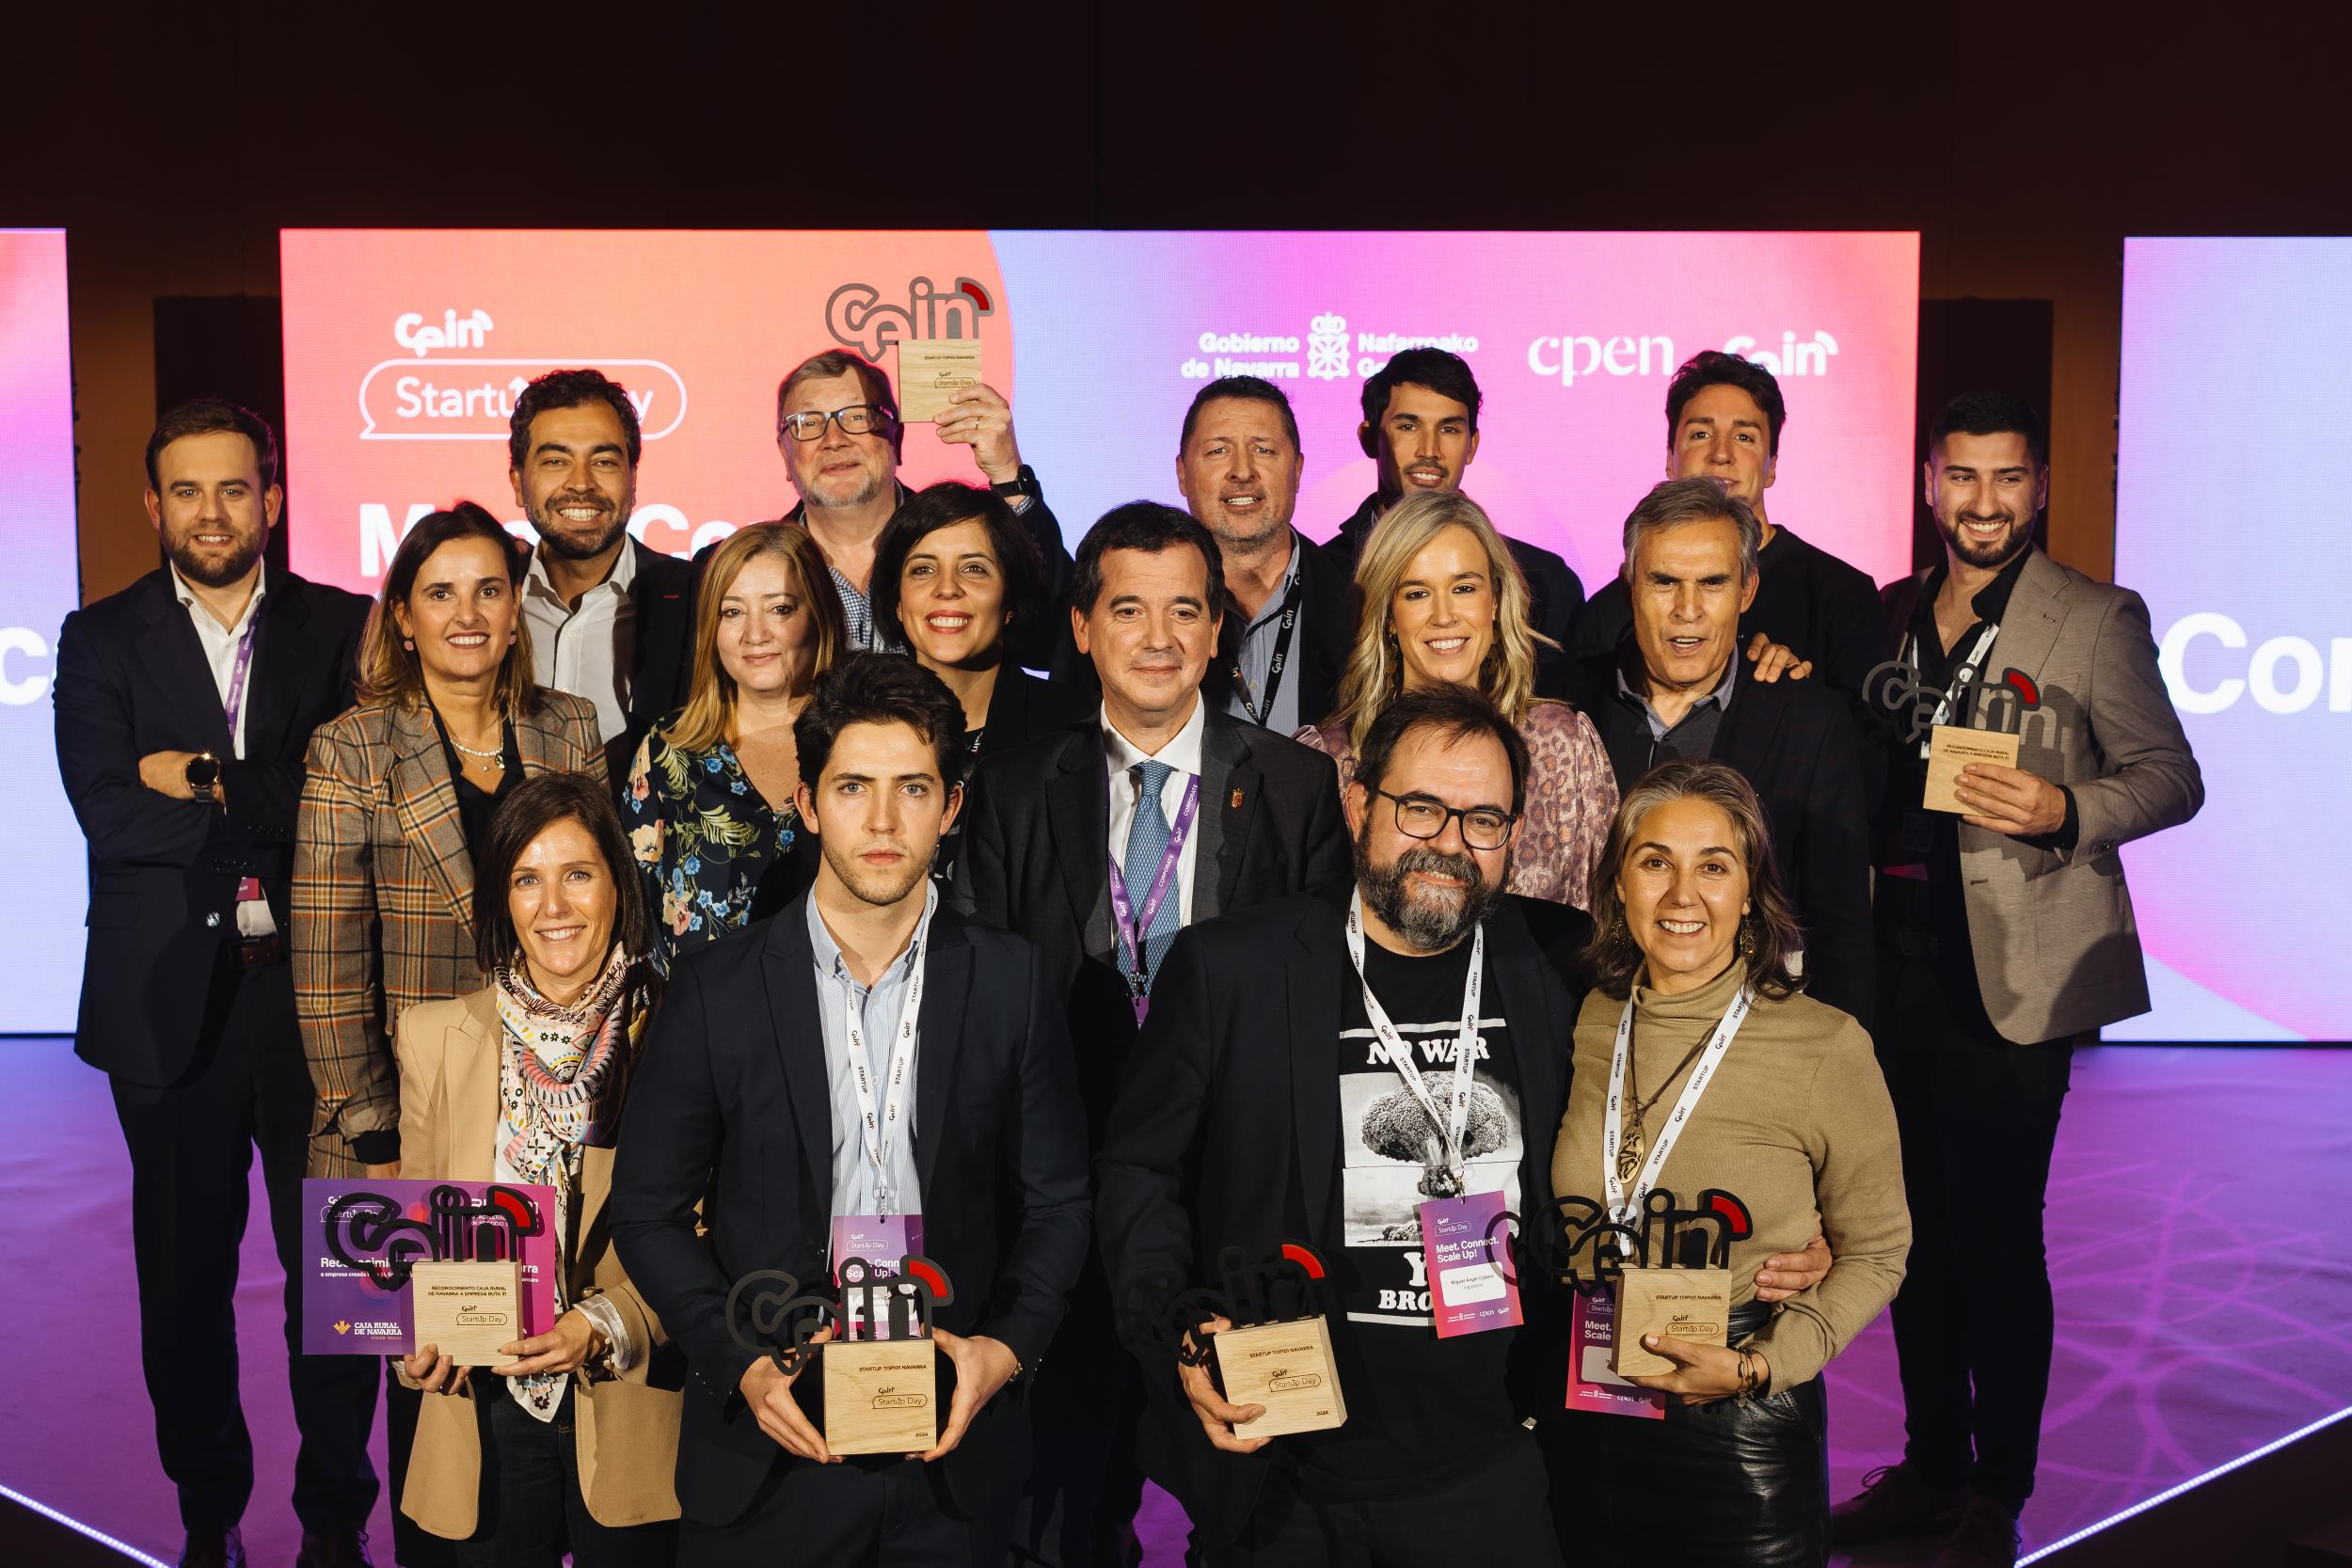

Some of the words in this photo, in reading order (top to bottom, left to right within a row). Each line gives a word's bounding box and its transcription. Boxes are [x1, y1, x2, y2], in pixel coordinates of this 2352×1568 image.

[1198, 332, 1300, 354] Gobierno
[1181, 357, 1210, 378] de
[1214, 358, 1300, 378] Navarra
[396, 375, 529, 419] Startu
[1158, 854, 1174, 887] CORPORATE
[1183, 784, 1199, 817] CORPORATE
[895, 1057, 904, 1085] STARTUP
[1399, 1057, 1416, 1082] STARTUP
[858, 1066, 868, 1094] STARTUP
[1653, 1139, 1669, 1165] STARTUP
[1693, 1065, 1709, 1091] STARTUP
[1436, 1242, 1460, 1253] Meet.
[1461, 1235, 1499, 1250] Connect.
[874, 1259, 900, 1268] Conn
[1437, 1251, 1461, 1263] Scale
[1462, 1249, 1478, 1260] Up!
[874, 1268, 891, 1279] Up!
[489, 1315, 502, 1324] Day
[1584, 1320, 1612, 1331] Meet.
[1584, 1330, 1612, 1340] Scale
[1700, 1325, 1714, 1334] Day
[907, 1397, 922, 1406] Day
